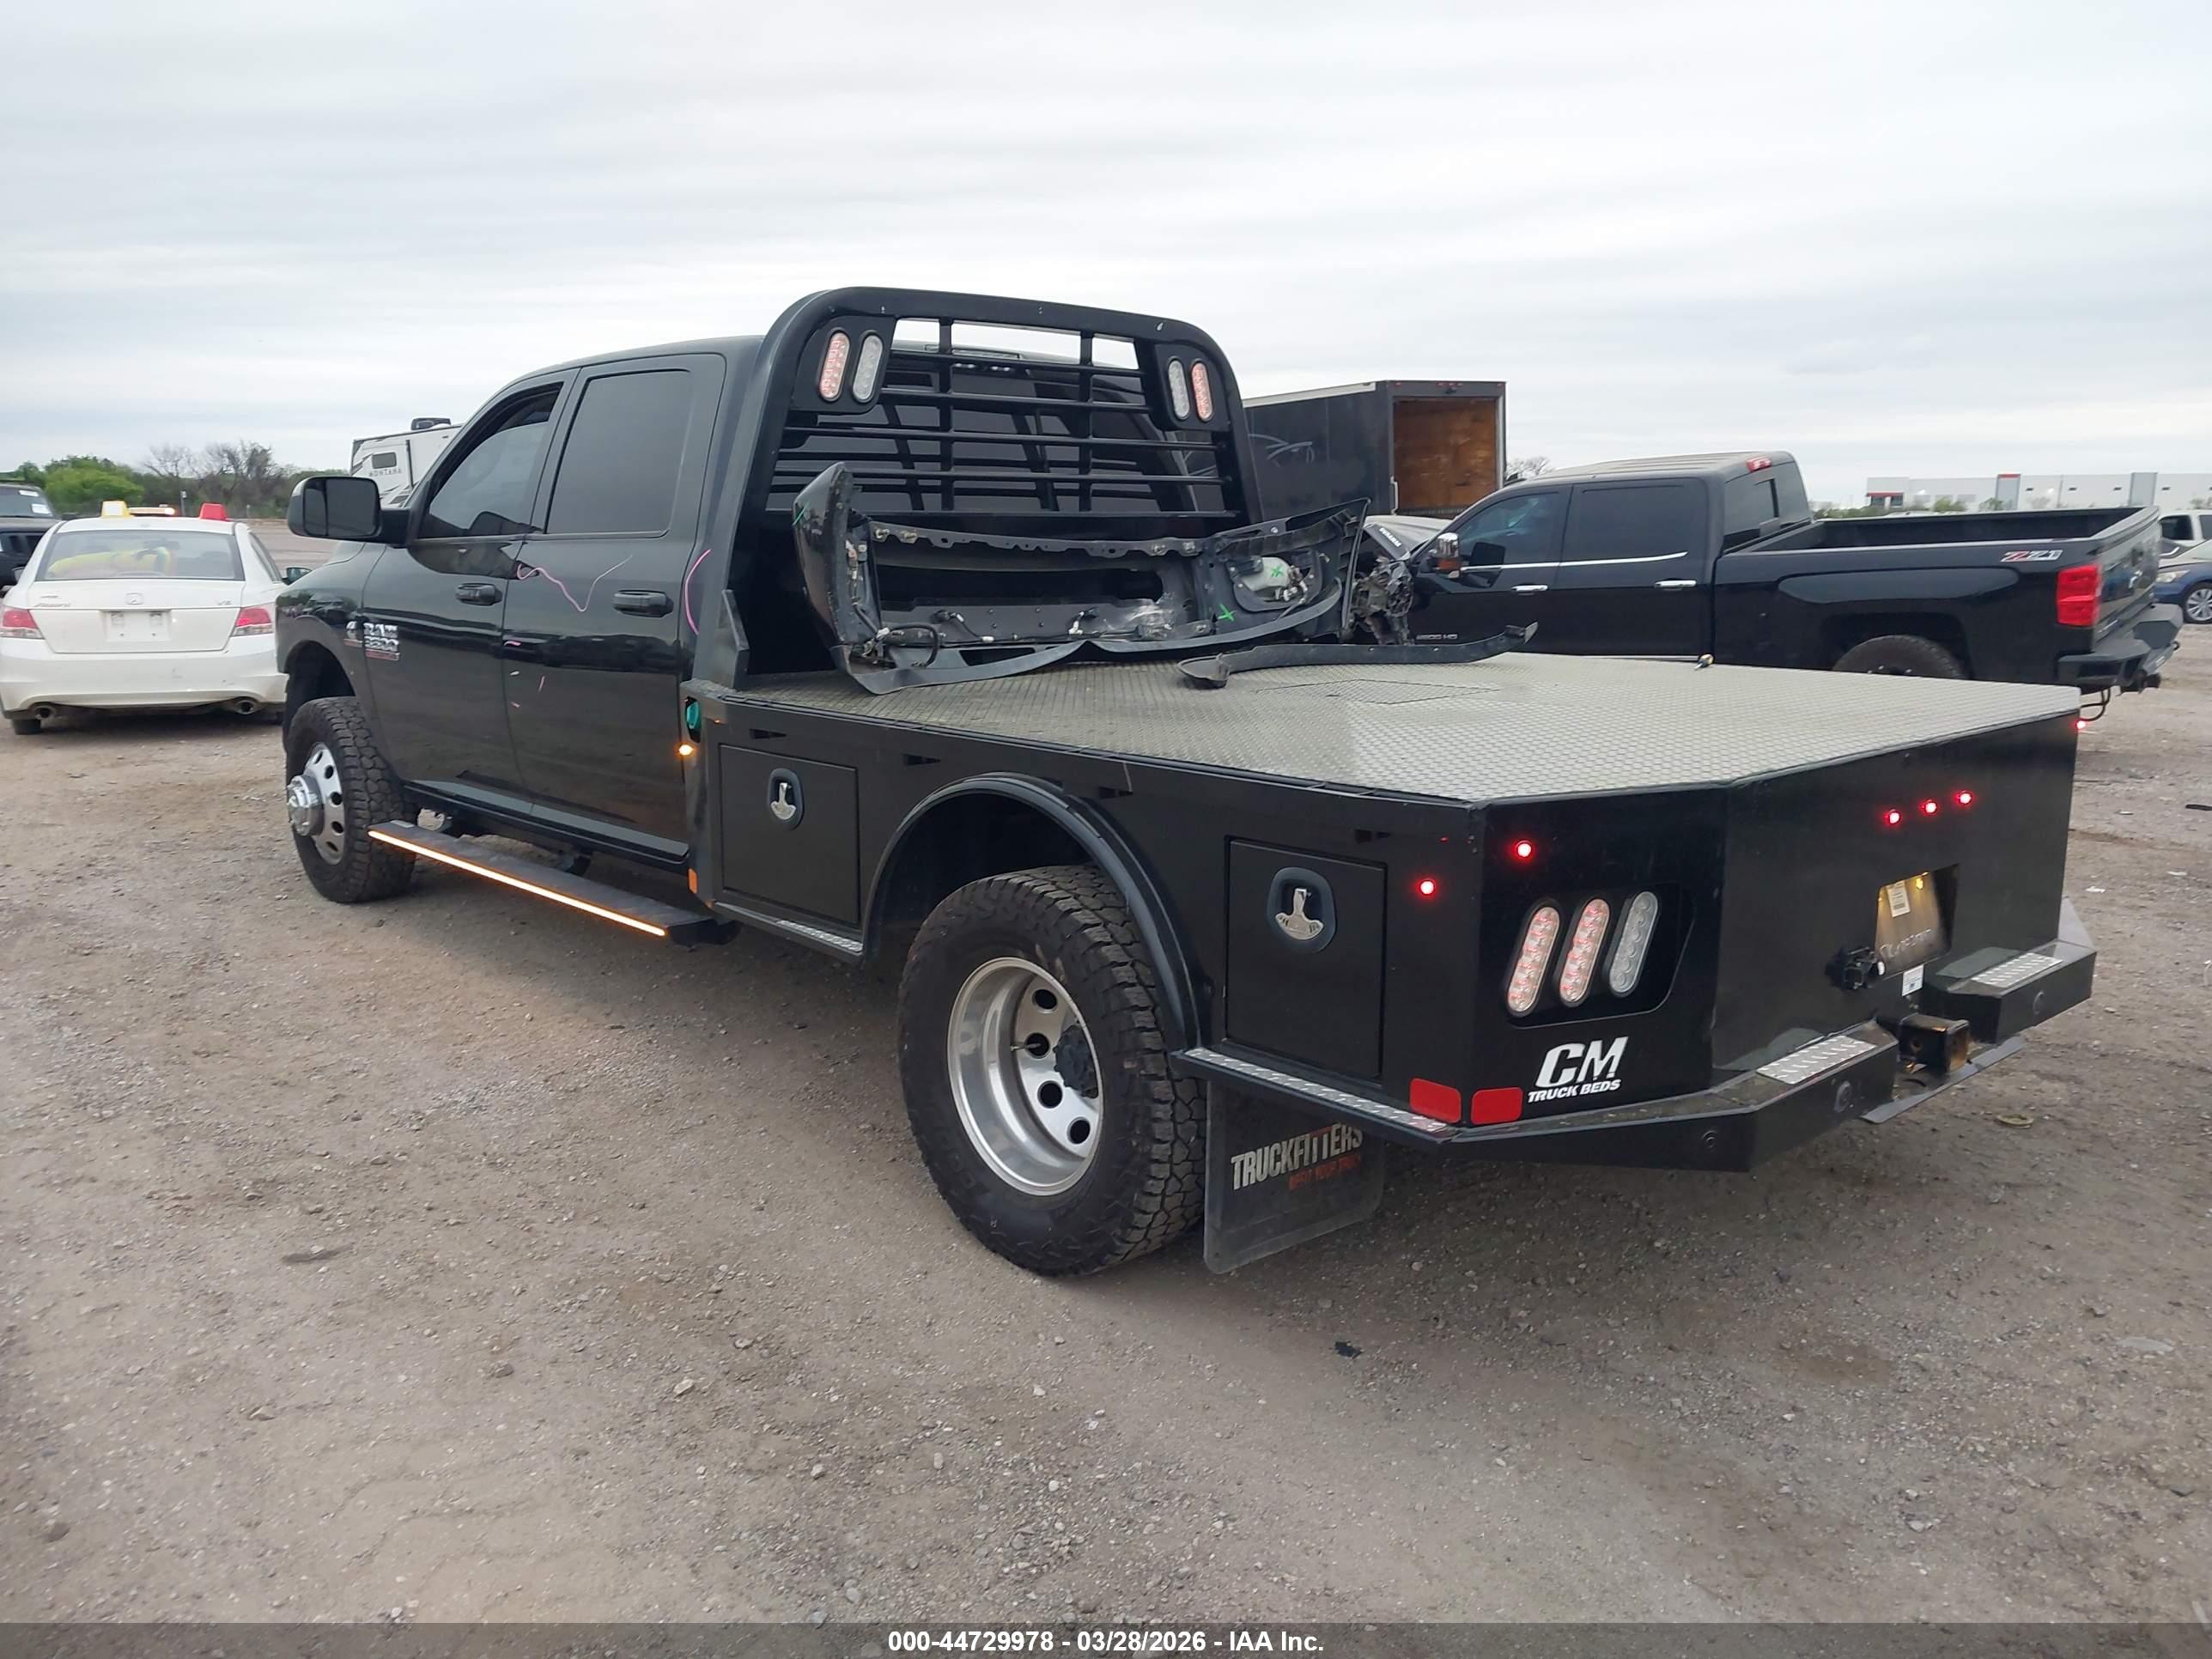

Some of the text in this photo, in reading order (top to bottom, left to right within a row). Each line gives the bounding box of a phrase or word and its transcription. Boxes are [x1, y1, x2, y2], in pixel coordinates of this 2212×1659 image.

[2001, 550, 2063, 562] Z71
[1535, 1036, 1629, 1088] CM
[1528, 1079, 1622, 1103] TRUCK BEDS
[1231, 1122, 1364, 1190] TRUCKFITTERS
